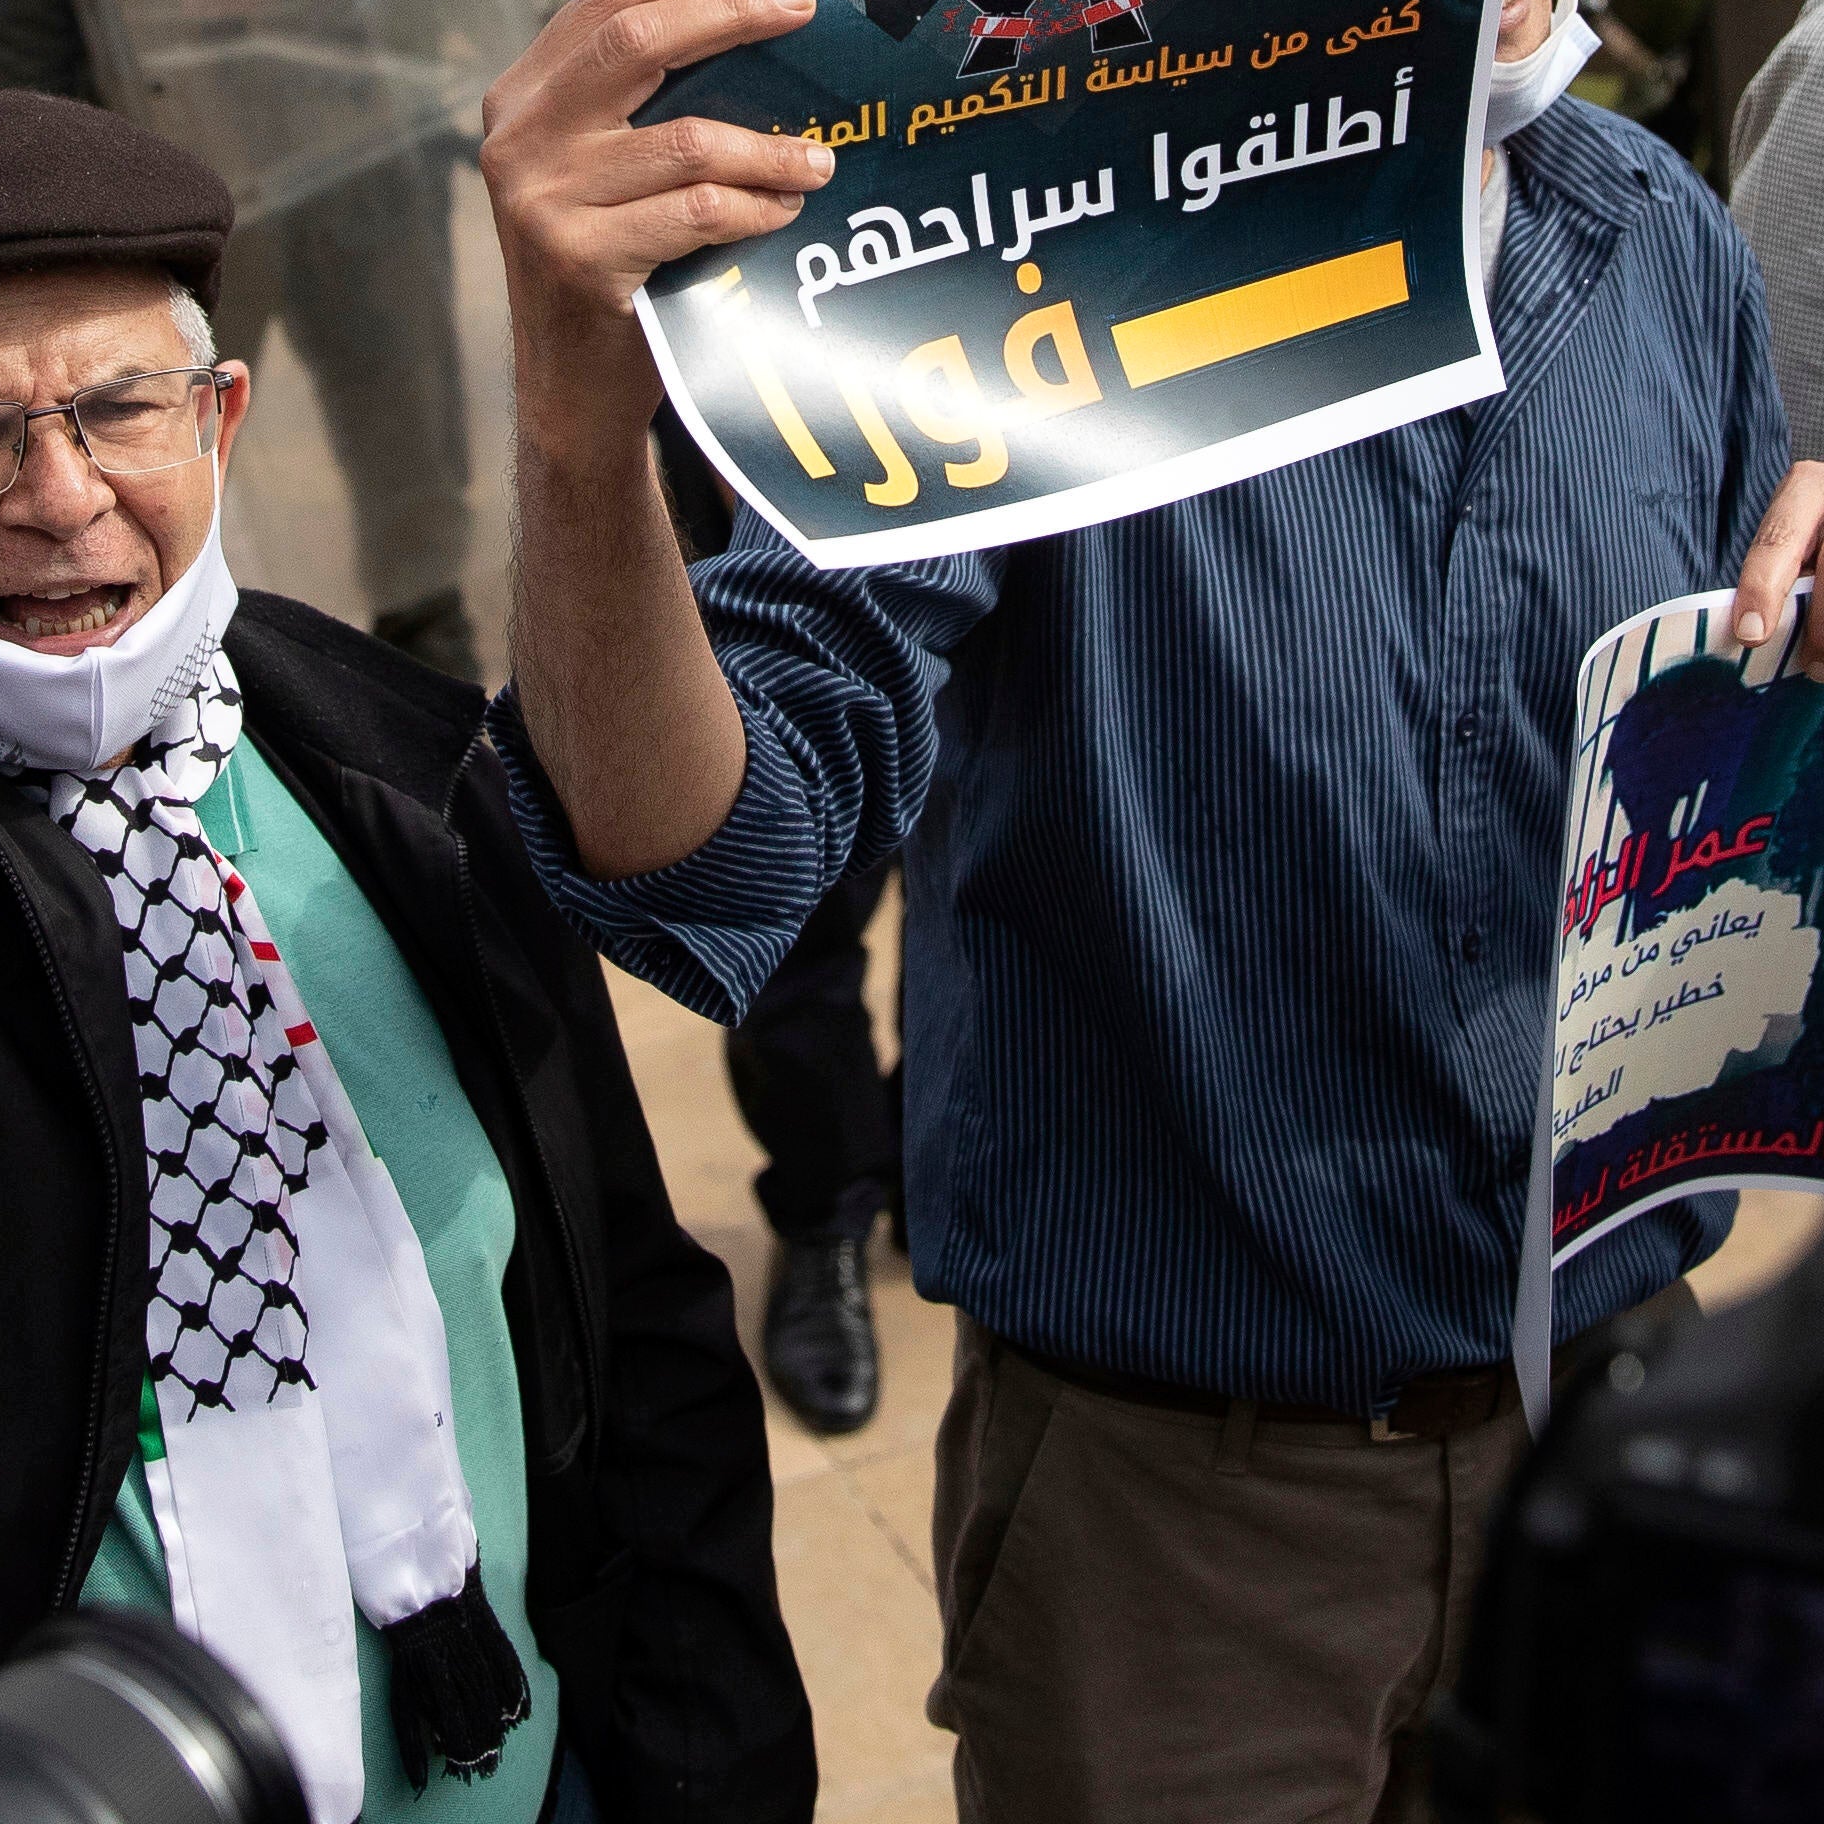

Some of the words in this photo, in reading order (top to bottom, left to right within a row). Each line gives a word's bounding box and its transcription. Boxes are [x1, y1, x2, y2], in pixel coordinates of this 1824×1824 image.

[1085, 41, 1234, 92] سياسة
[1250, 26, 1310, 71] من
[773, 100, 886, 149] المف
[907, 64, 1068, 145] التكميم
[1153, 65, 1416, 213] أطلقوا
[793, 165, 1116, 329] سراحهم
[1651, 814, 1774, 898] عمر
[1621, 941, 1660, 976] من
[1670, 909, 1766, 966] يعاني
[1559, 963, 1613, 1022] مرض
[1644, 972, 1726, 1029] خطير
[1568, 1008, 1641, 1076] يحتاج
